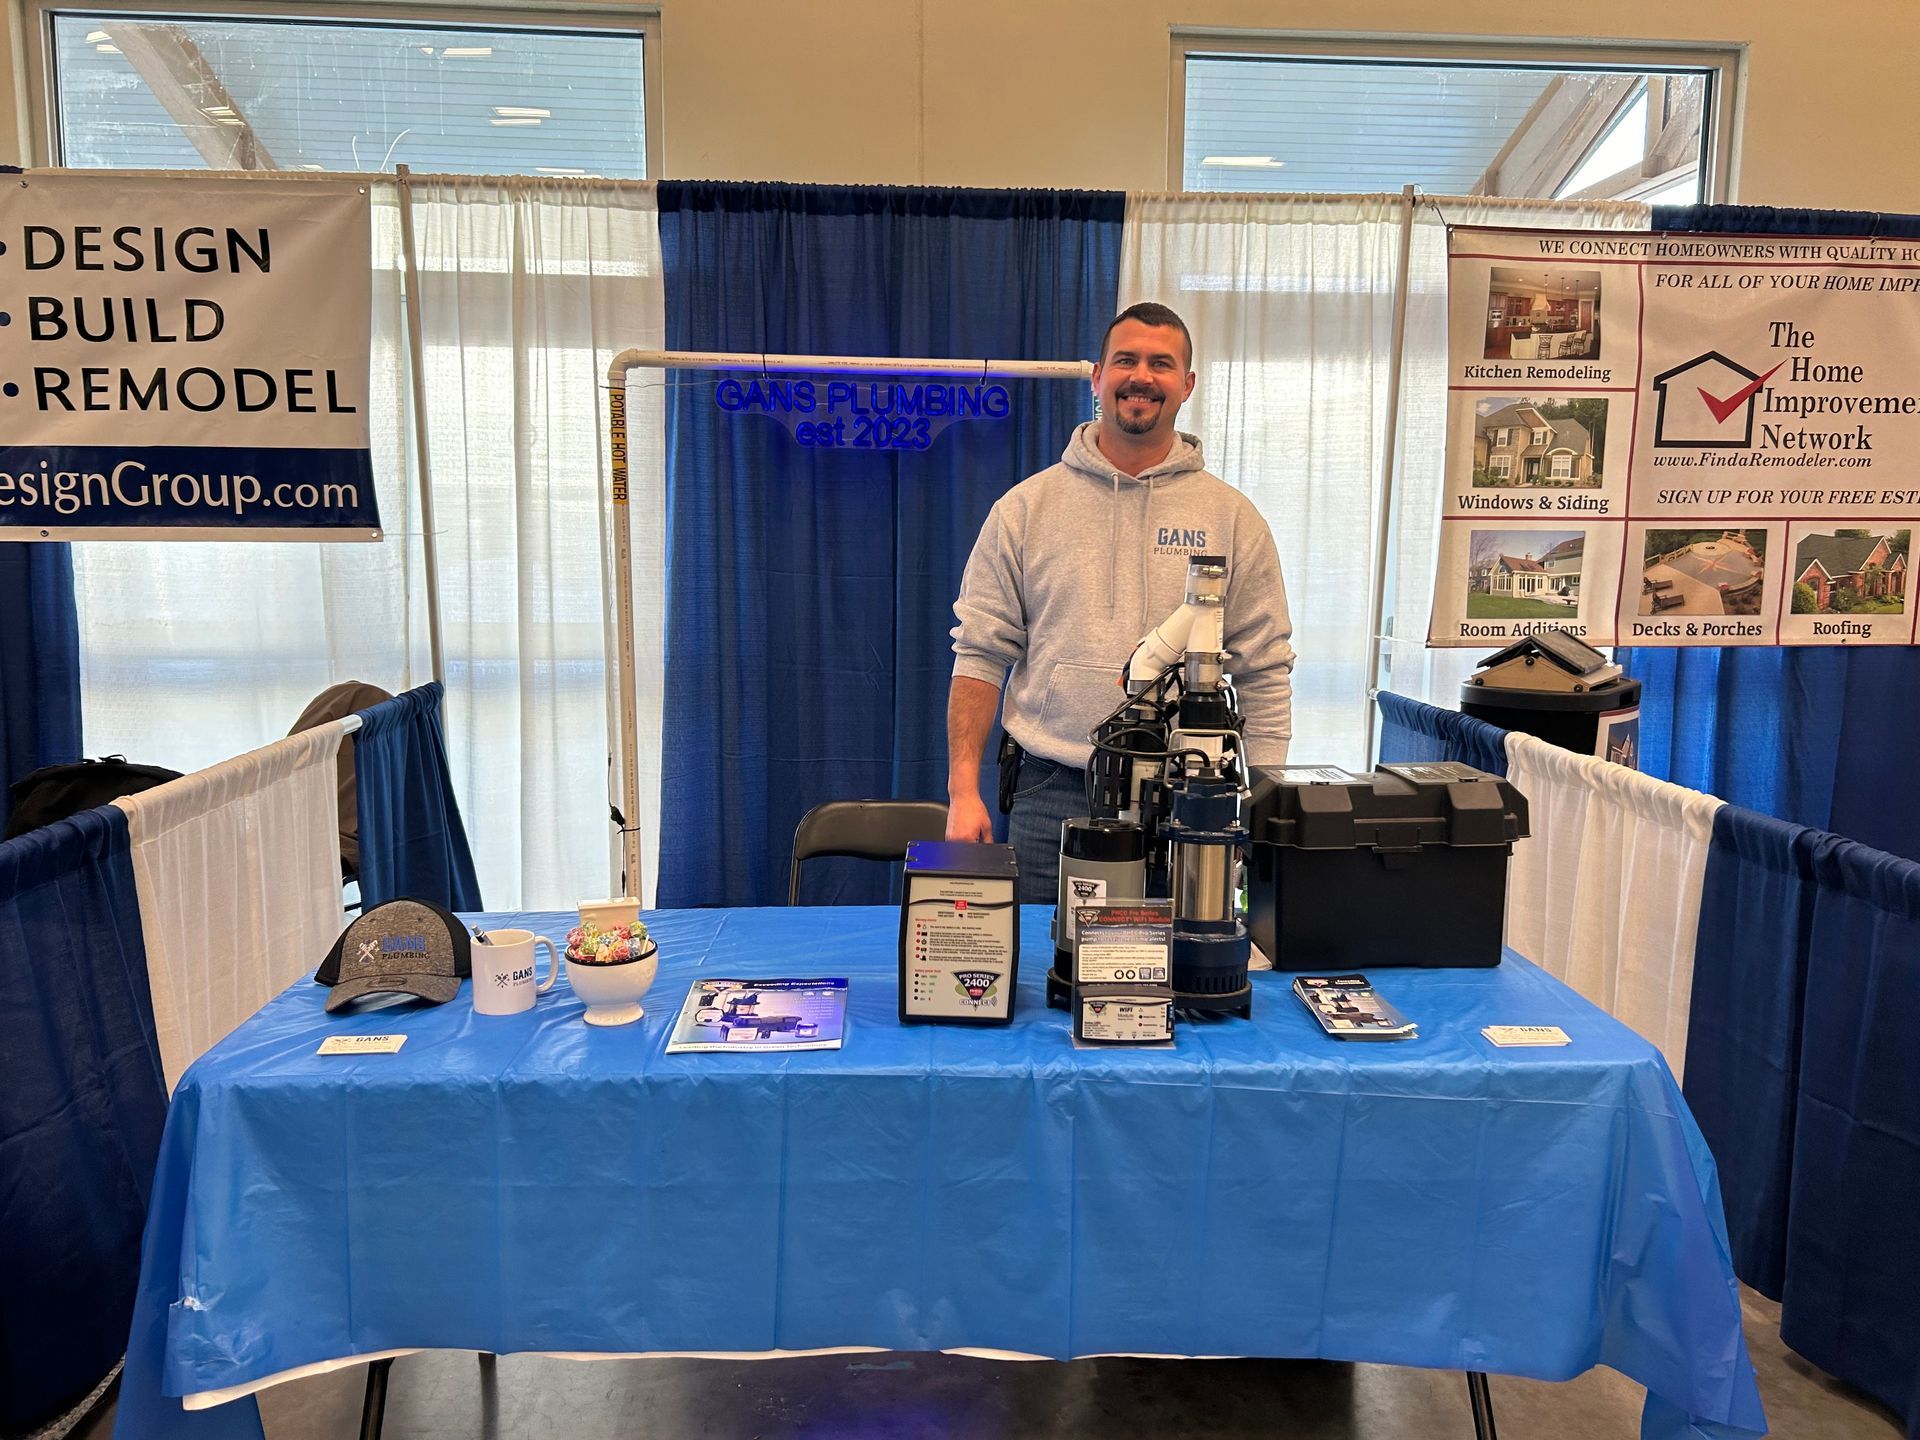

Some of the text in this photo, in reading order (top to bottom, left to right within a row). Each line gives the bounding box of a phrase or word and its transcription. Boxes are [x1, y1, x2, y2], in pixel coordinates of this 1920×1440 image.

[24, 225, 271, 273] DESIGN
[1538, 240, 1564, 254] WE
[1569, 241, 1651, 255] CONNECT
[1655, 243, 1775, 258] HOMEOWNERS
[1779, 246, 1821, 258] WITH
[1826, 246, 1897, 261] QUALITY
[1655, 274, 1693, 288] FOR
[1697, 274, 1733, 289] ALL
[1738, 275, 1764, 289] OF
[1769, 275, 1820, 289] YOUR
[1823, 275, 1874, 291] HOME
[28, 296, 225, 342] BUILD
[1768, 321, 1815, 349] The
[1464, 365, 1612, 382] Kitchen Remodeling
[1789, 356, 1864, 383] Home
[33, 367, 357, 413] REMODEL
[716, 379, 1010, 418] GANS PLUMBING
[1762, 387, 1920, 418] Improveme
[610, 394, 625, 438] POTABLE
[795, 416, 931, 449] est 2023
[1759, 424, 1873, 450] Network
[612, 443, 626, 463] HOT
[1653, 452, 1873, 468] www.FindaRemodeler.com
[613, 467, 627, 500] WATER
[1458, 494, 1609, 514] Windows & Siding
[1657, 489, 1703, 504] SIGN
[1707, 490, 1731, 504] UP
[1735, 490, 1773, 504] FOR
[1779, 490, 1824, 504] YOUR
[1827, 490, 1876, 504] FREE
[1157, 527, 1206, 548] GANS
[1153, 547, 1207, 556] PLUMBING
[1460, 623, 1506, 637] Room
[1632, 621, 1763, 636] Decks & Porches
[1813, 620, 1872, 638] Roofing
[383, 935, 426, 952] GANS
[382, 951, 430, 960] PLUMBING
[512, 966, 533, 981] GANS
[963, 978, 990, 987] 2400
